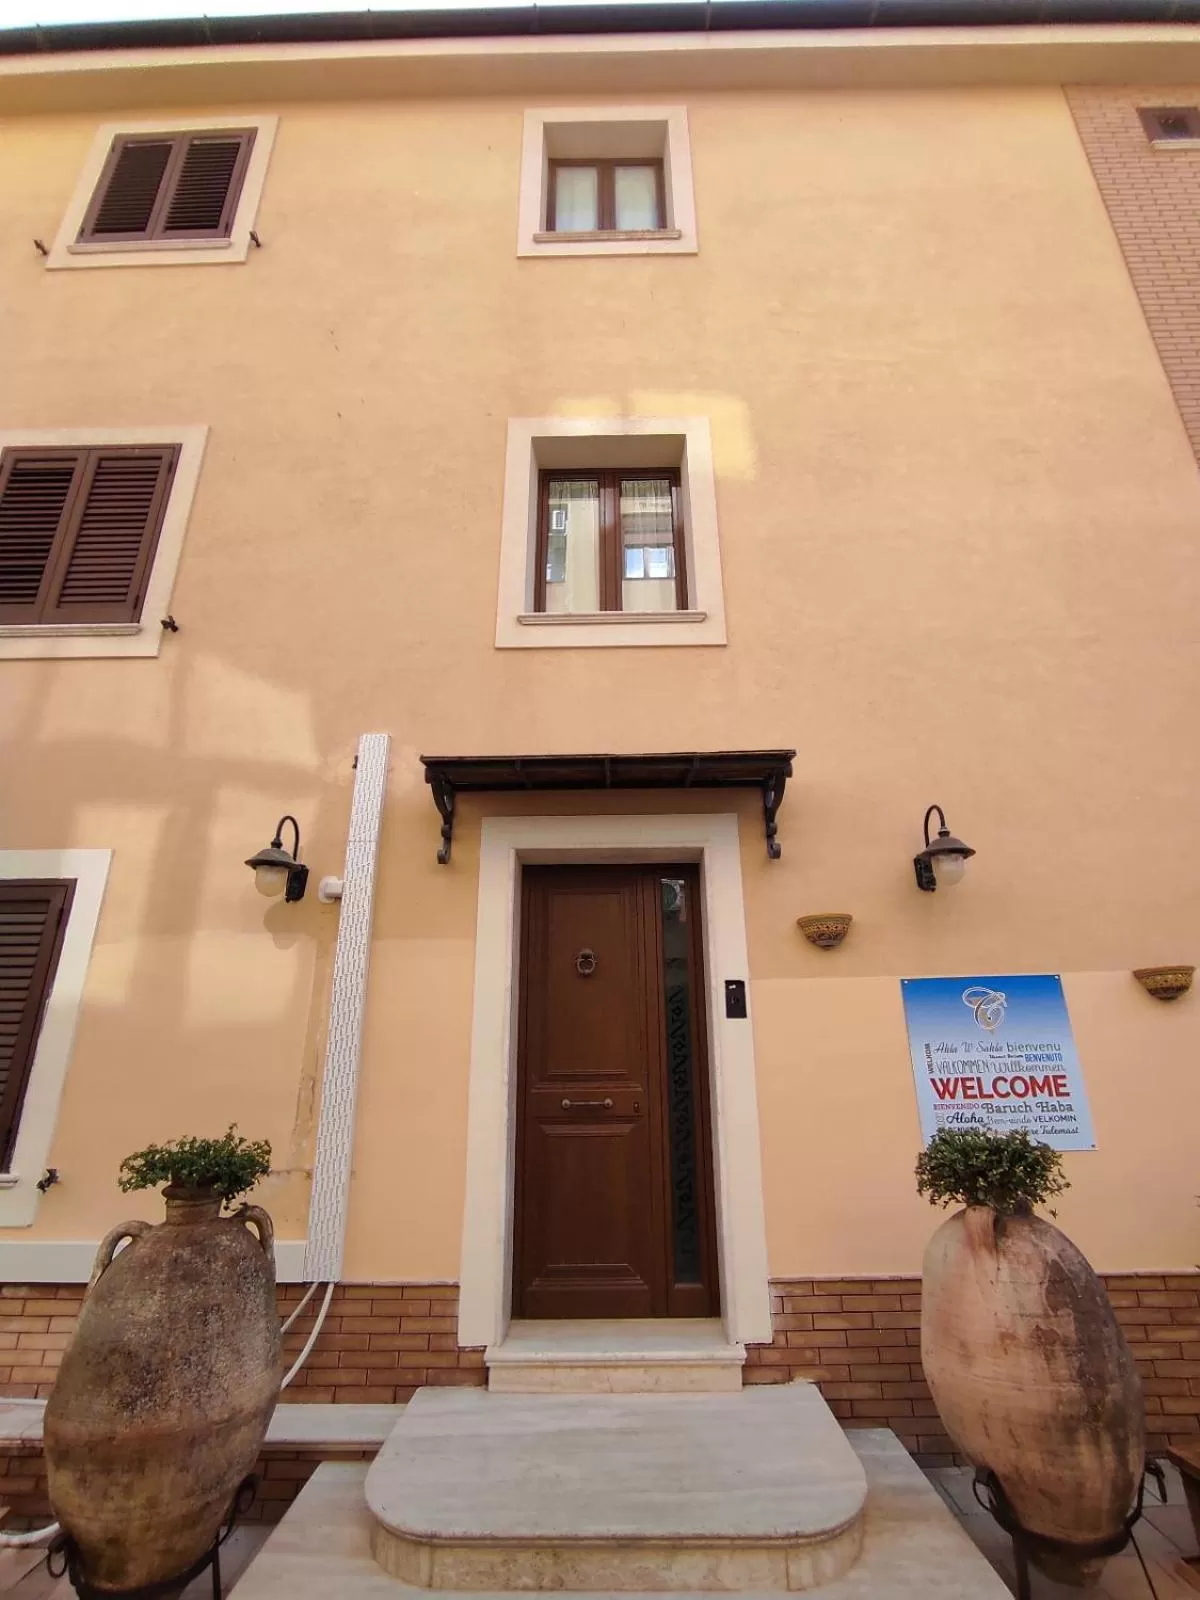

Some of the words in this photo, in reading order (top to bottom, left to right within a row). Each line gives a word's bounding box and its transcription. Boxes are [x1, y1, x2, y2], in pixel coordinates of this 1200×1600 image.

[1006, 1041, 1061, 1052] bienvenu
[1024, 1053, 1063, 1062] BENVENUTO
[930, 1075, 1070, 1100] WELCOME
[980, 1101, 1033, 1114] Baruch
[1035, 1100, 1074, 1113] Haba
[945, 1111, 984, 1124] Aloha
[1032, 1114, 1077, 1123] VELKOMIN
